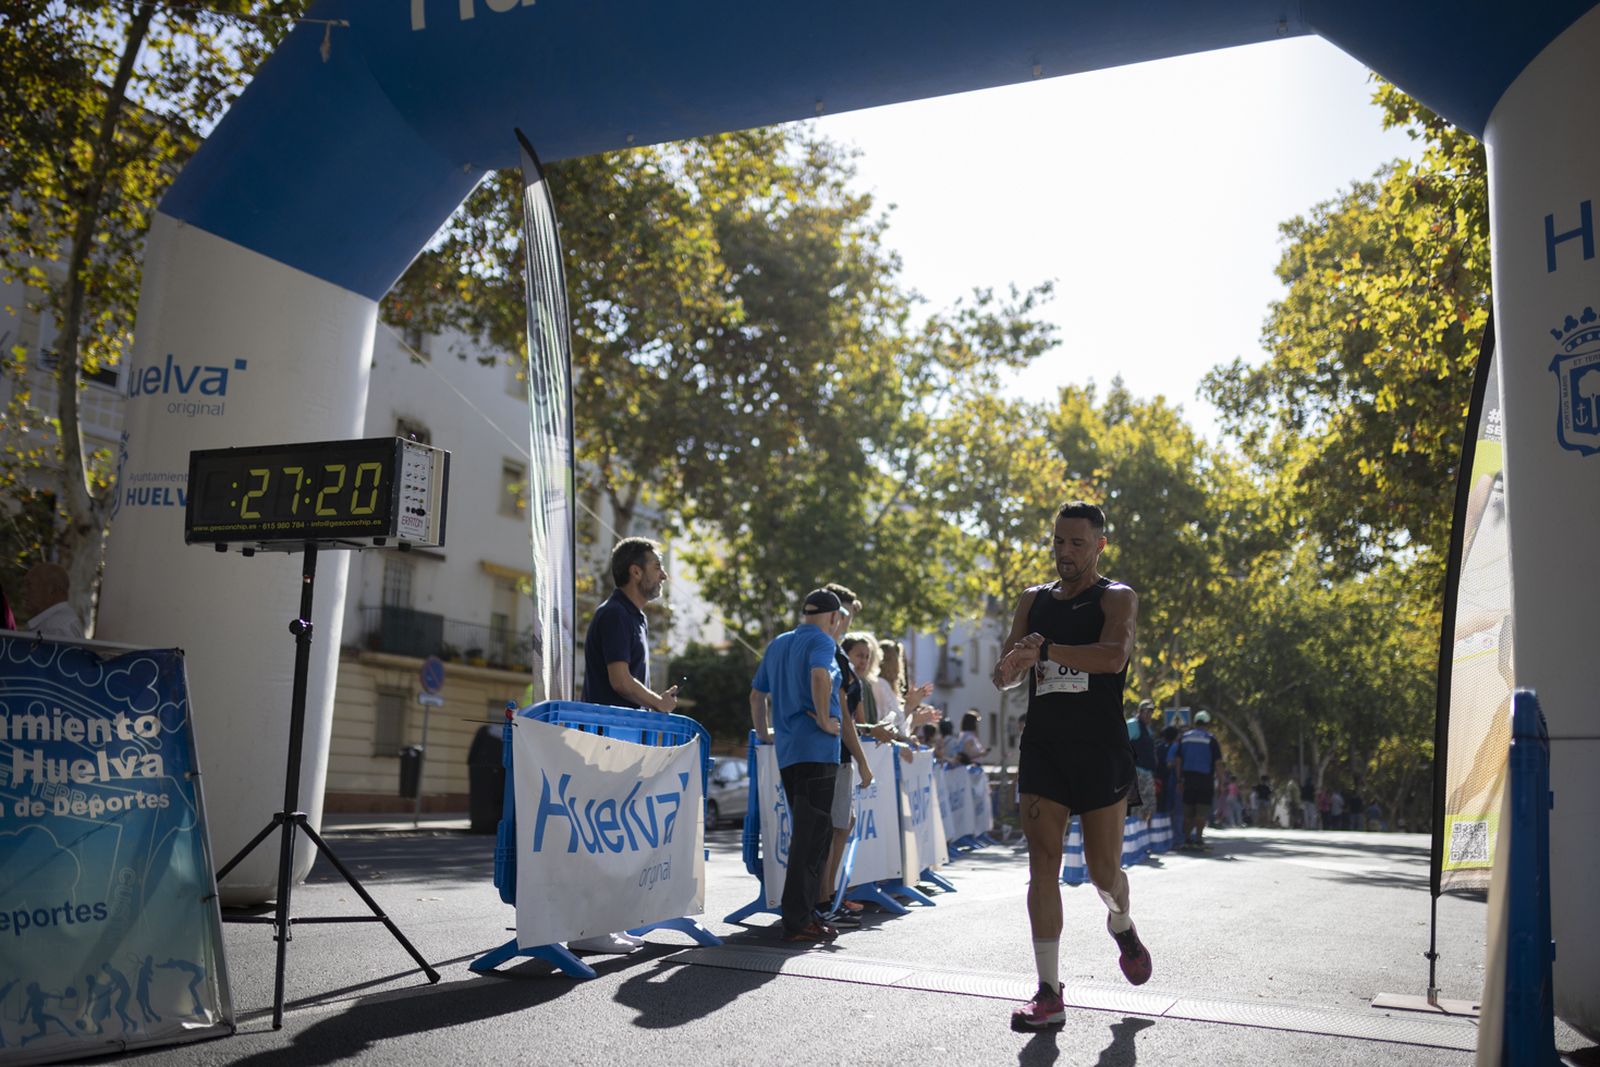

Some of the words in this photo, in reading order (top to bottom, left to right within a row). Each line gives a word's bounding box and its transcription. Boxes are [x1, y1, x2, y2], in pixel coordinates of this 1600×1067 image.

[129, 354, 229, 398] uelva
[167, 400, 225, 417] original
[311, 518, 382, 528] info@gesconchip.es
[12, 749, 164, 784] Huelva
[14, 796, 46, 817] de
[54, 790, 170, 818] Deportes
[533, 768, 681, 854] Huelva
